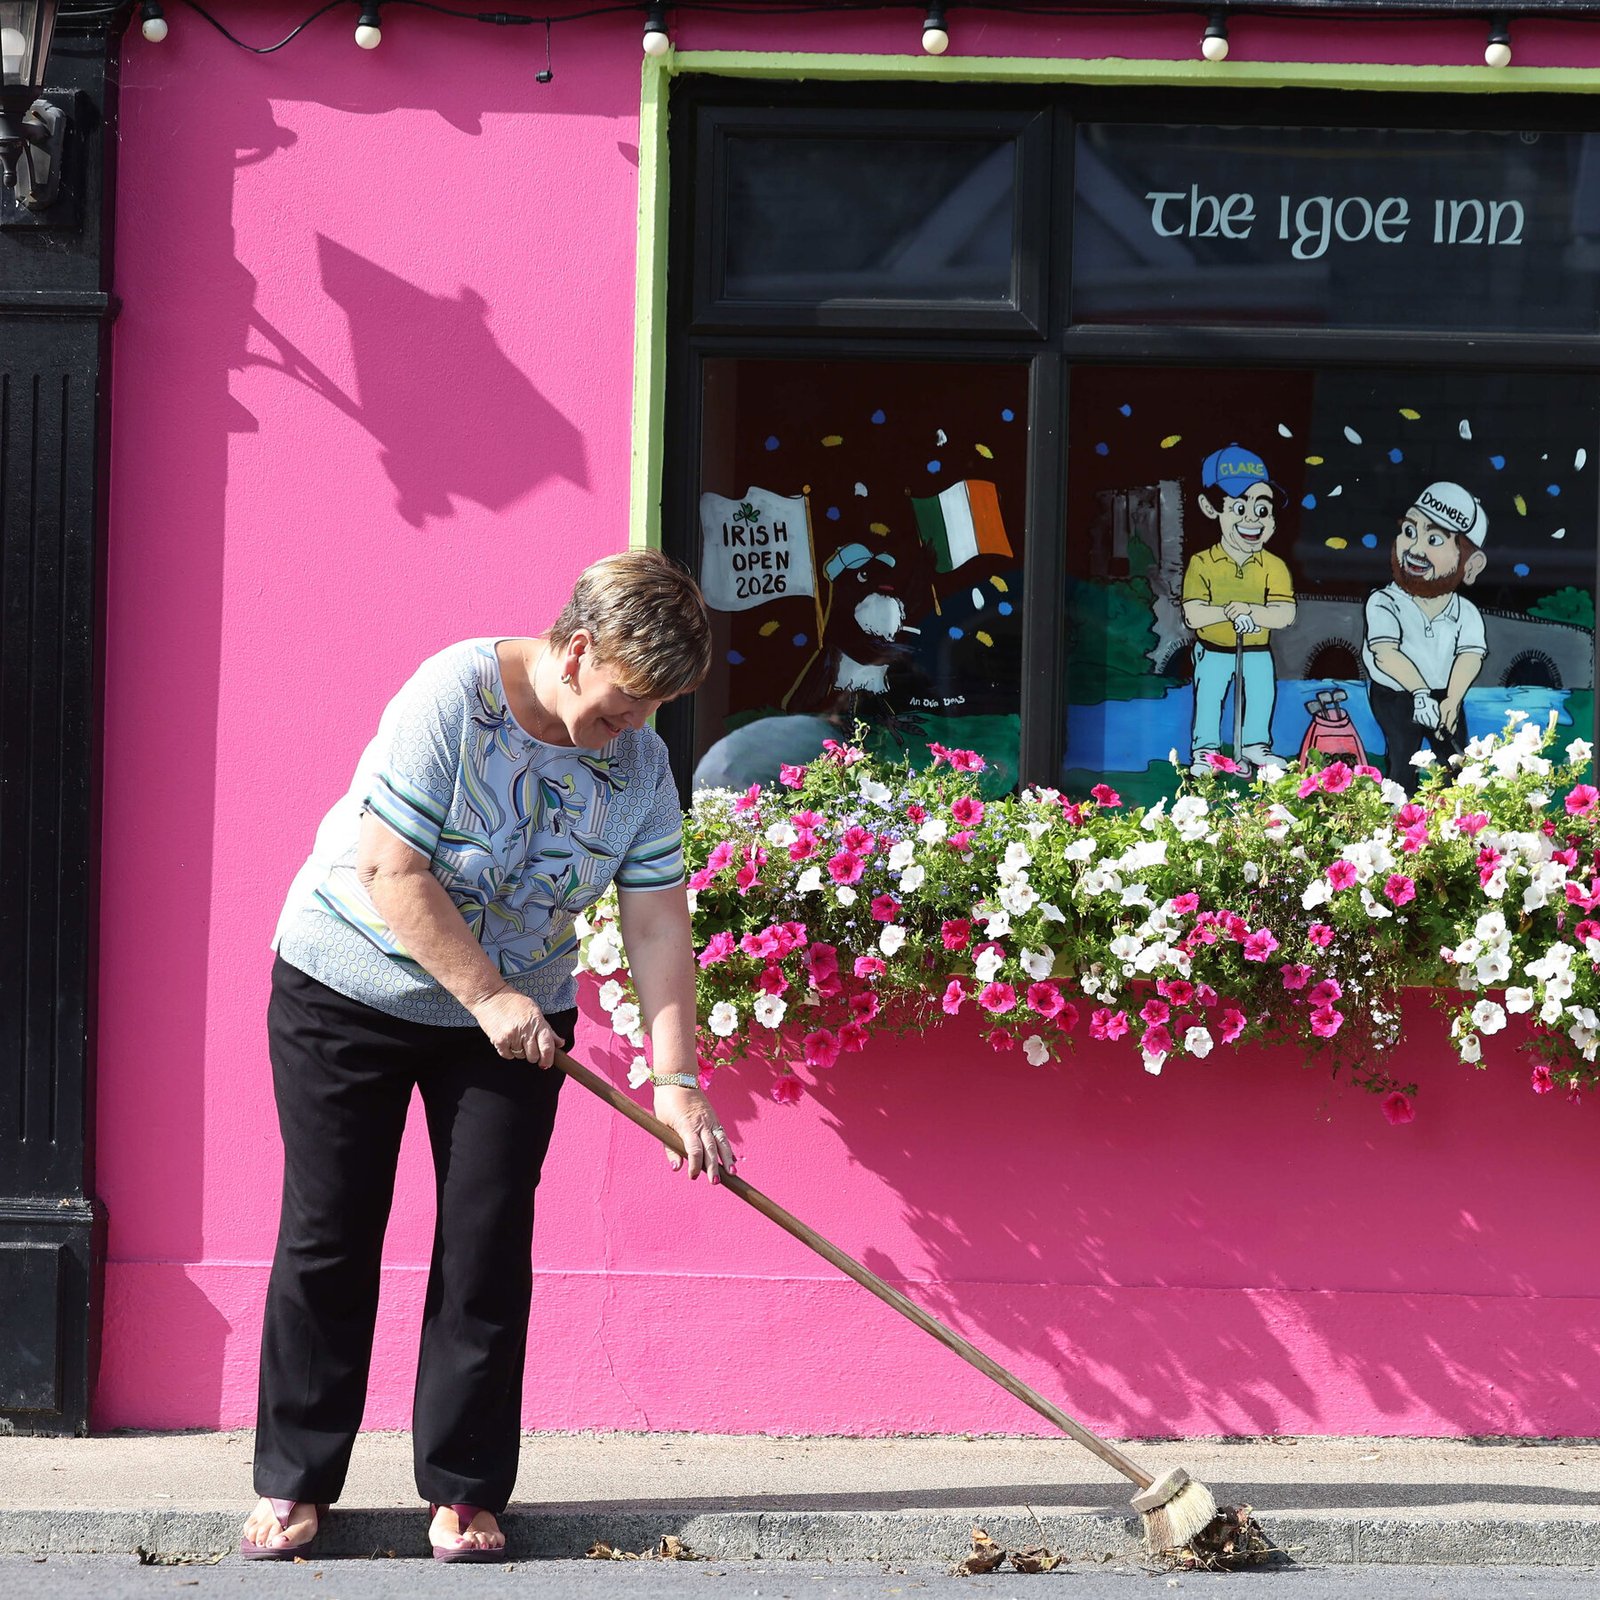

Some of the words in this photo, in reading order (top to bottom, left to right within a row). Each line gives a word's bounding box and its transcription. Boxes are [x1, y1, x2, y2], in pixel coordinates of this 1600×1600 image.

[1145, 184, 1257, 239] The
[1278, 195, 1412, 260] Igoe
[1433, 198, 1526, 246] Inn
[1220, 462, 1265, 477] CLARE
[1420, 491, 1470, 529] DOONBEG
[722, 522, 788, 547] IRISH
[732, 551, 789, 572] OPEN
[735, 574, 787, 599] 2026
